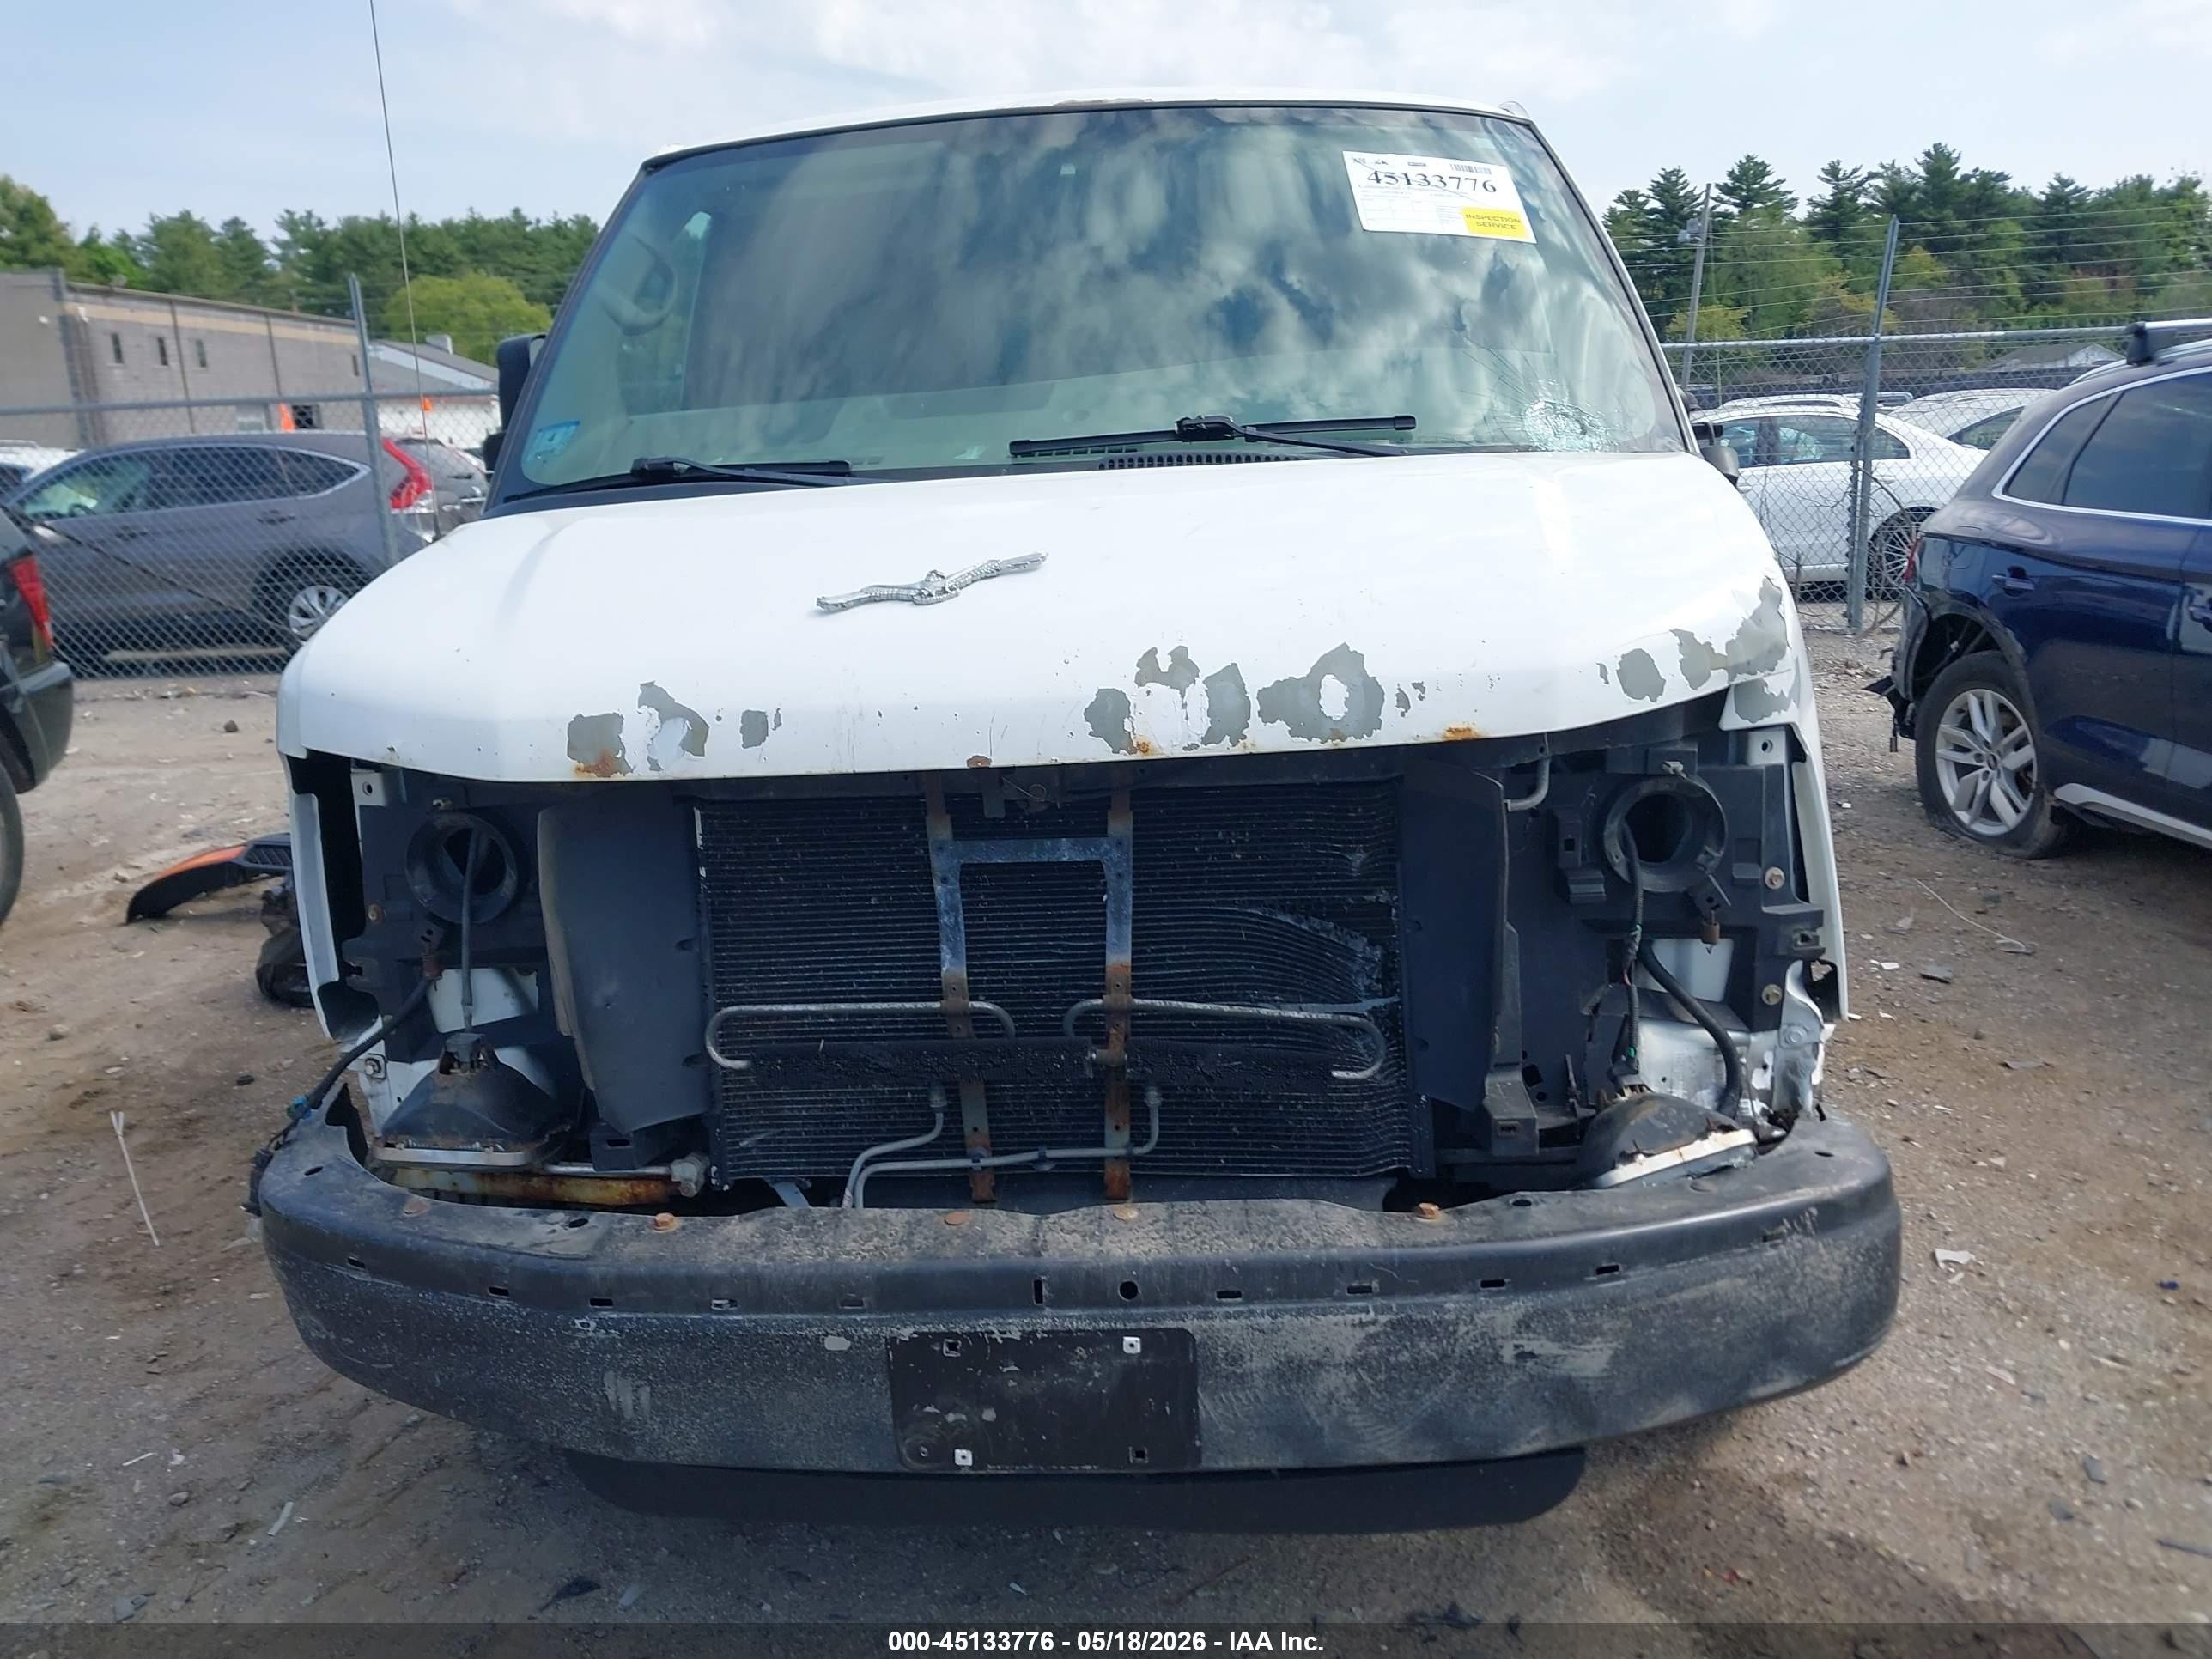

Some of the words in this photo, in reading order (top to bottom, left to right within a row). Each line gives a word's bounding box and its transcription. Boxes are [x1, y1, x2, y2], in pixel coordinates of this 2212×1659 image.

[1367, 170, 1497, 193] 45133776
[1465, 214, 1522, 223] INSPECTION
[1475, 221, 1517, 230] SERVICE
